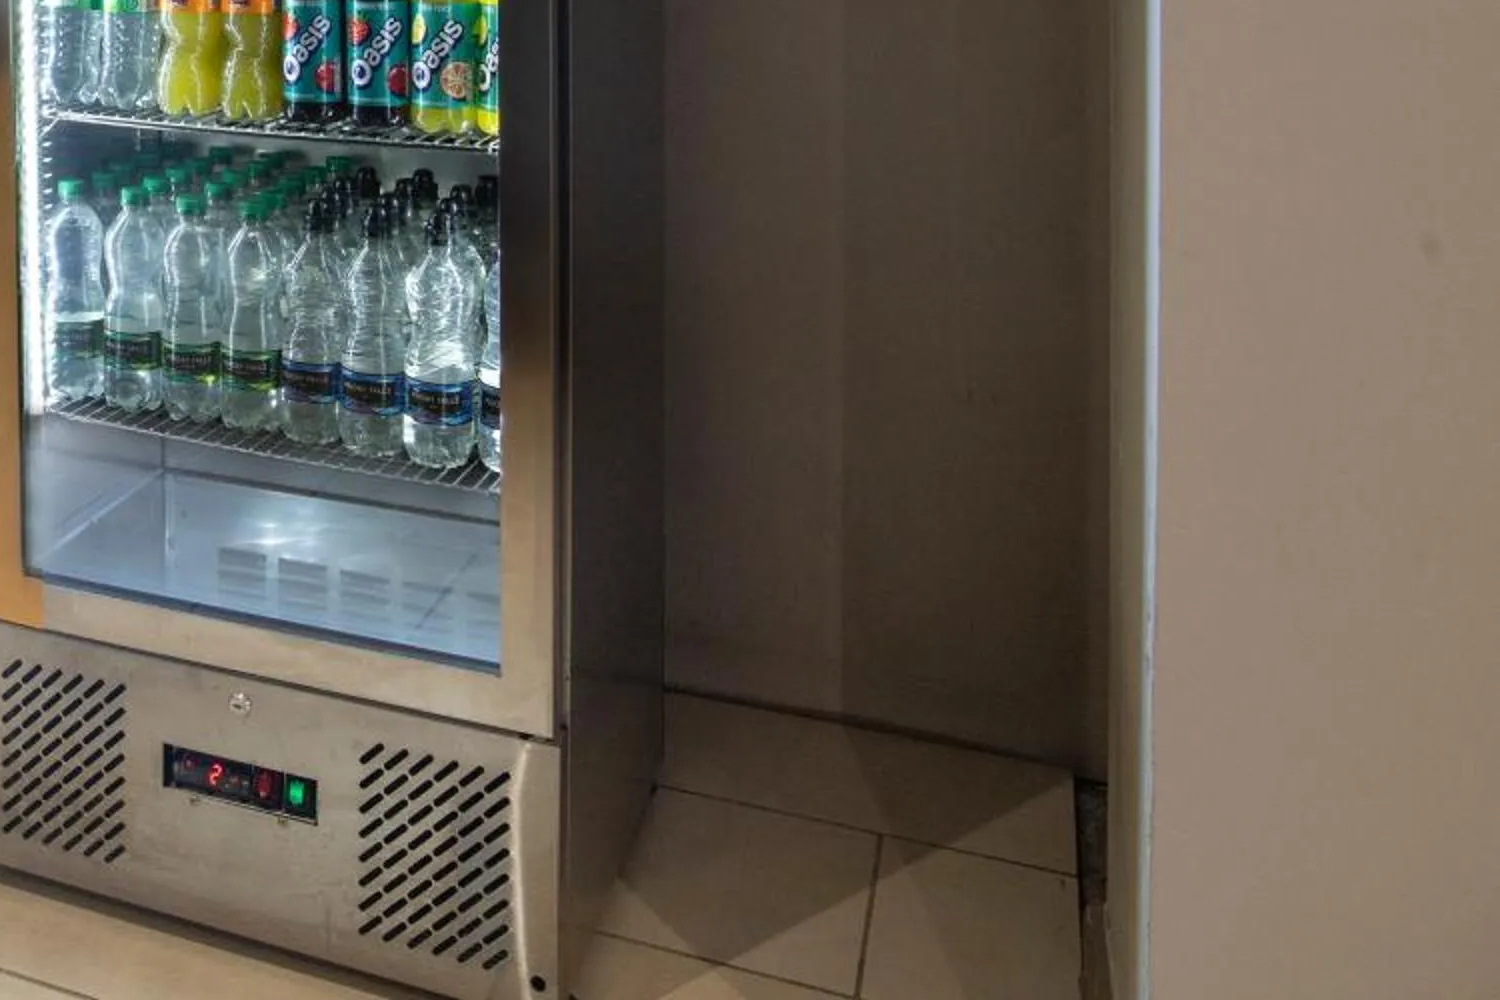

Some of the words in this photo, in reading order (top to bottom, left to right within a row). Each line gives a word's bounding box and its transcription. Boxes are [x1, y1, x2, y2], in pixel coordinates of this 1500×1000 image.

[283, 14, 331, 82] Oasis
[352, 16, 403, 86] Oasis
[411, 19, 464, 90] Oasis
[208, 762, 224, 786] 2
